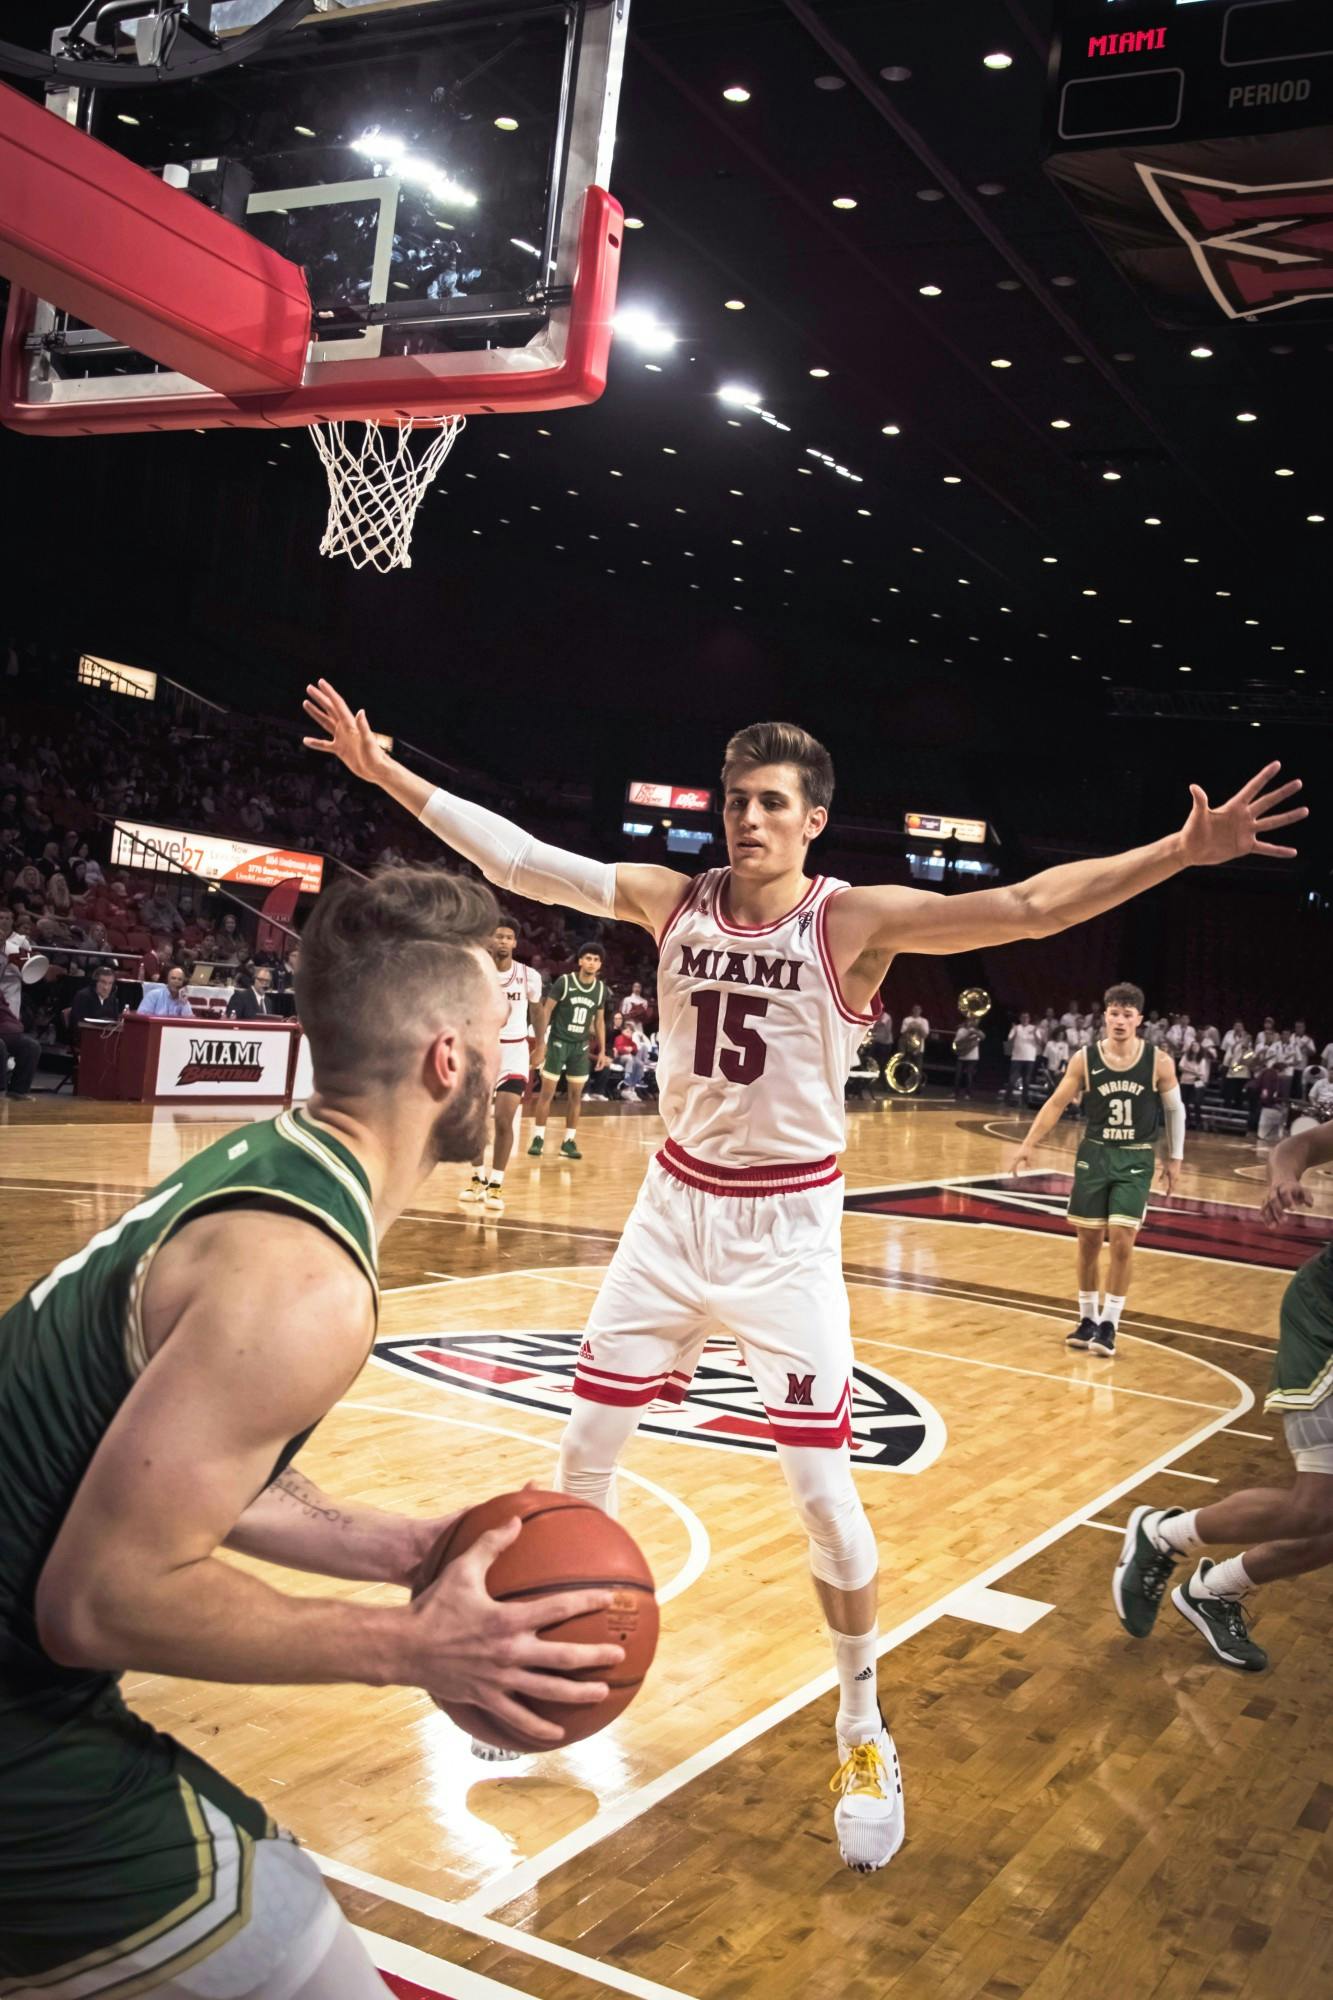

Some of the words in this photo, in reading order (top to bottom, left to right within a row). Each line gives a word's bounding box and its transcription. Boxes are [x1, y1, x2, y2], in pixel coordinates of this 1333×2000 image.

[1088, 27, 1167, 57] MIAMI
[1229, 79, 1311, 108] PERIOD
[678, 944, 804, 992] MIAMI
[572, 1006, 588, 1025] 10
[691, 989, 769, 1086] 15
[189, 1039, 262, 1066] MIAMI
[1097, 1080, 1145, 1097] WRIGHT
[1108, 1098, 1133, 1126] 31
[1102, 1128, 1135, 1140] STATE
[784, 1373, 817, 1406] M
